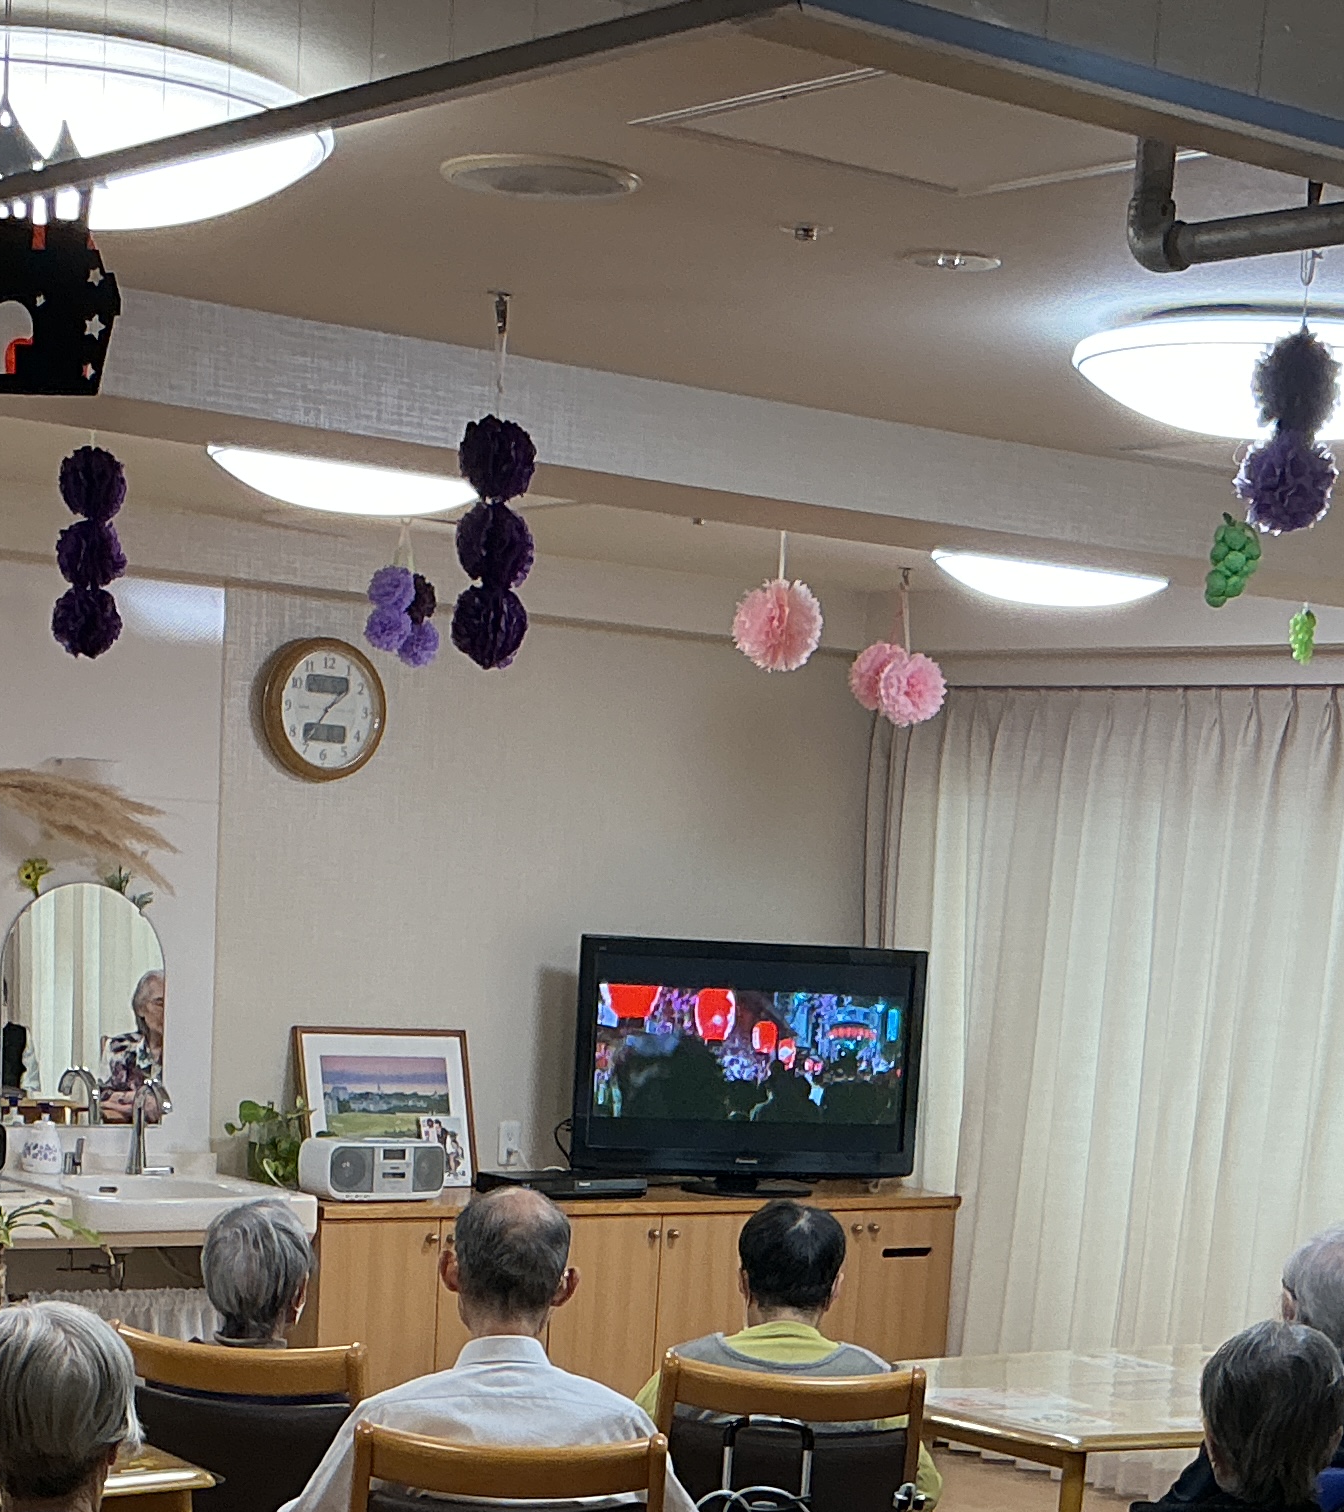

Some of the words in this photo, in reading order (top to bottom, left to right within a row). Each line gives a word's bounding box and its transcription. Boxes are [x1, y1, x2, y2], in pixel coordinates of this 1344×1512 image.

[304, 660, 315, 673] 11
[323, 656, 336, 669] 12
[291, 676, 304, 690] 10
[357, 683, 365, 696] 2
[284, 699, 293, 712] 9
[361, 707, 369, 720] 3
[289, 724, 297, 738] 8
[354, 730, 361, 744] 4
[319, 749, 327, 761] 6
[341, 747, 349, 758] 5
